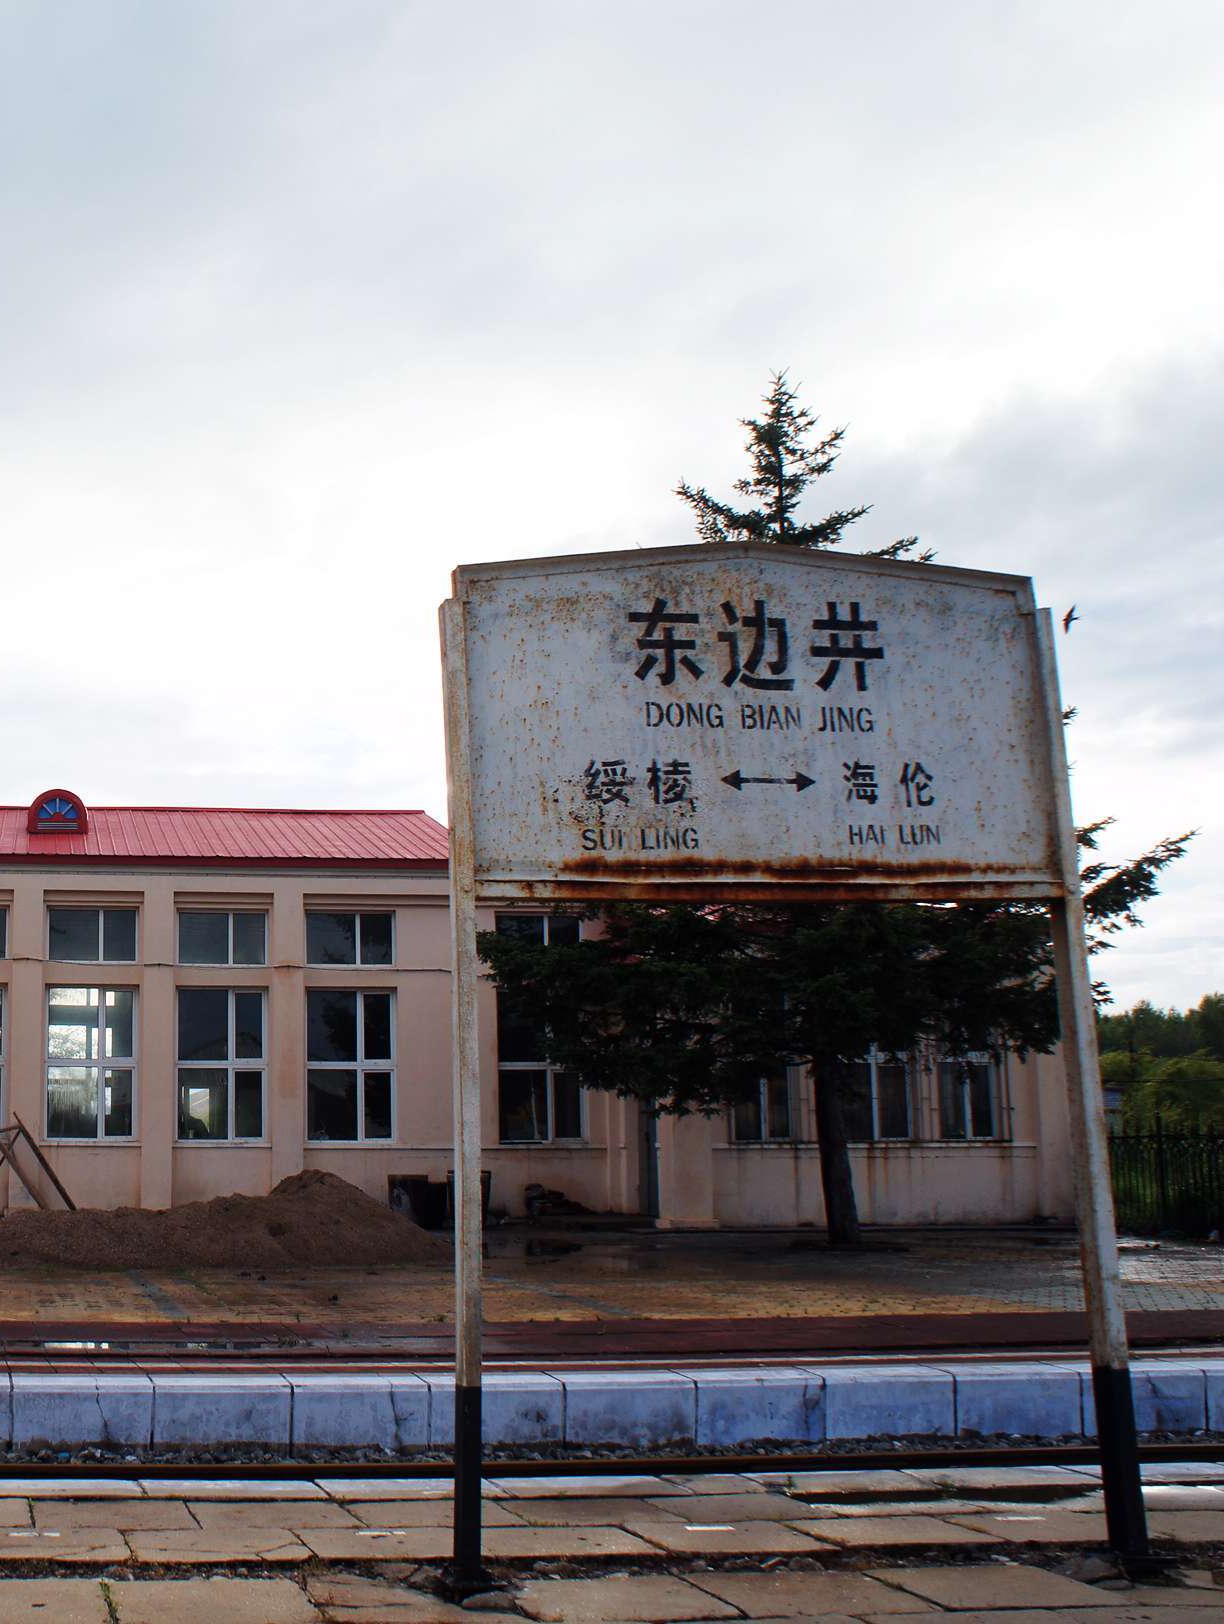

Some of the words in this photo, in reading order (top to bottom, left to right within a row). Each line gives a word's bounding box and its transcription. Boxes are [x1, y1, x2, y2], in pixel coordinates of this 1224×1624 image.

[628, 598, 884, 692] 东边井
[645, 702, 725, 729] DONG
[741, 704, 802, 731] BIAN
[817, 706, 875, 733] JING
[583, 759, 693, 806] 绥棱
[842, 759, 935, 808] 海伦
[640, 827, 698, 851] LING
[848, 824, 886, 847] HAI
[898, 824, 941, 846] LUN
